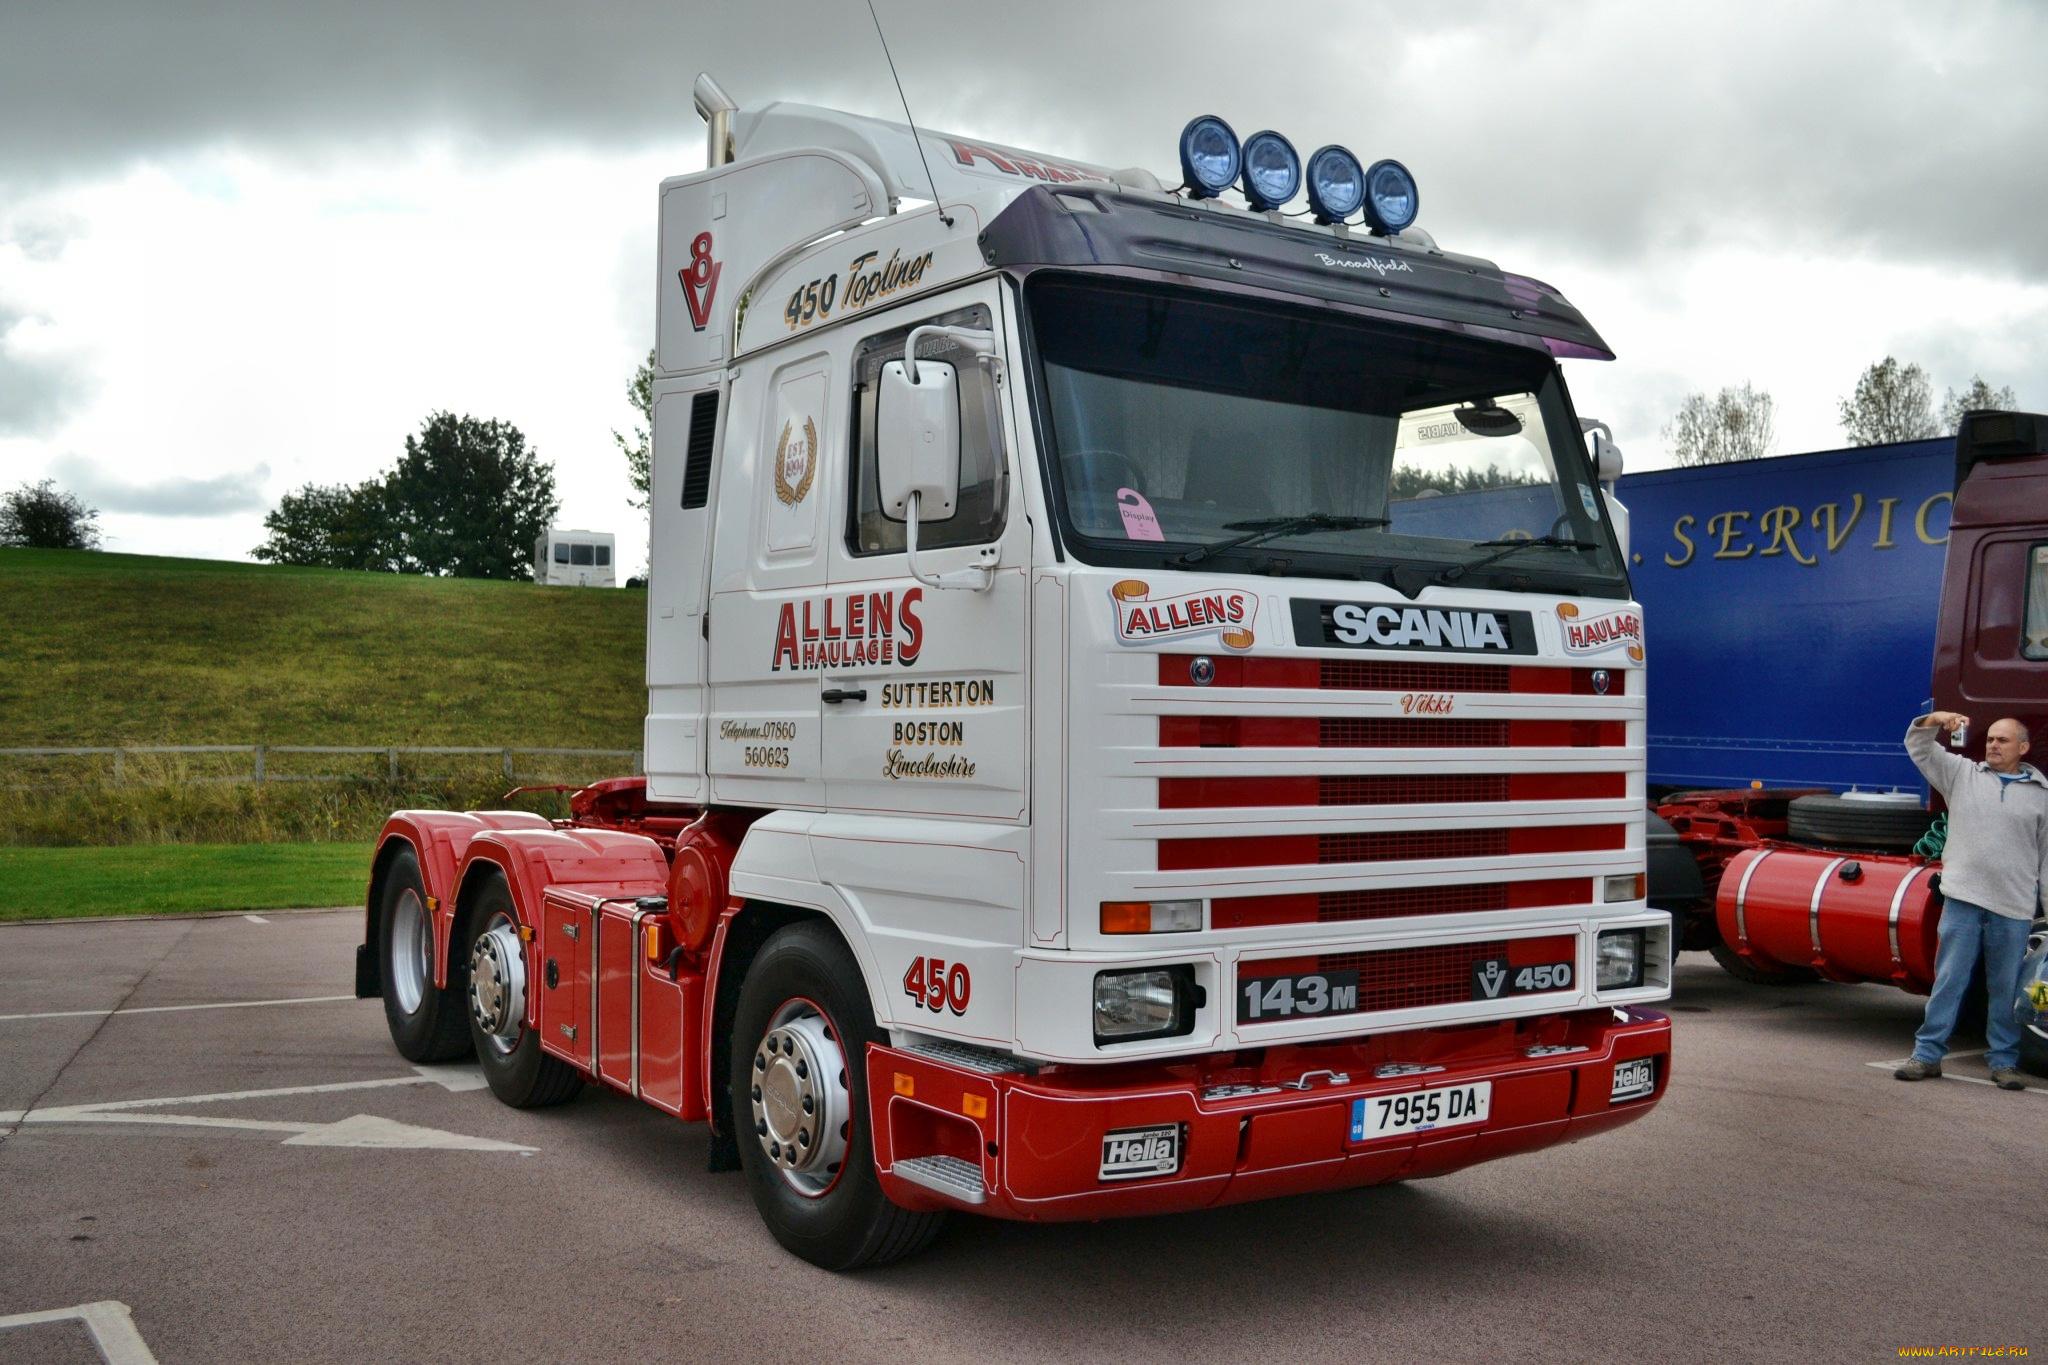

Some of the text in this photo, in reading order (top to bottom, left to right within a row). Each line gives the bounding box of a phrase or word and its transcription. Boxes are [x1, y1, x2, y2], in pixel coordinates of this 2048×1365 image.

[1314, 253, 1413, 276] Broadfield
[784, 248, 933, 331] 450 Topliner
[1122, 510, 1154, 523] Display
[1126, 595, 1244, 634] ALLENS
[1332, 604, 1509, 649] SCANIA
[772, 587, 923, 672] ALLENS
[1568, 615, 1640, 648] HAULAGE
[802, 638, 894, 669] HAULAGE
[881, 679, 995, 709] SUTTERTON
[1400, 693, 1455, 715] Vikki
[763, 722, 796, 741] 07860
[893, 721, 964, 746] BOSTON
[745, 746, 789, 768] 560623
[882, 747, 977, 779] Lincolnshire
[903, 956, 971, 1017] 450
[1515, 963, 1571, 990] 450
[1613, 1065, 1649, 1088] Hella
[1377, 1087, 1476, 1130] 7955 DA
[1352, 1124, 1362, 1134] GB
[1107, 1138, 1171, 1164] Hella
